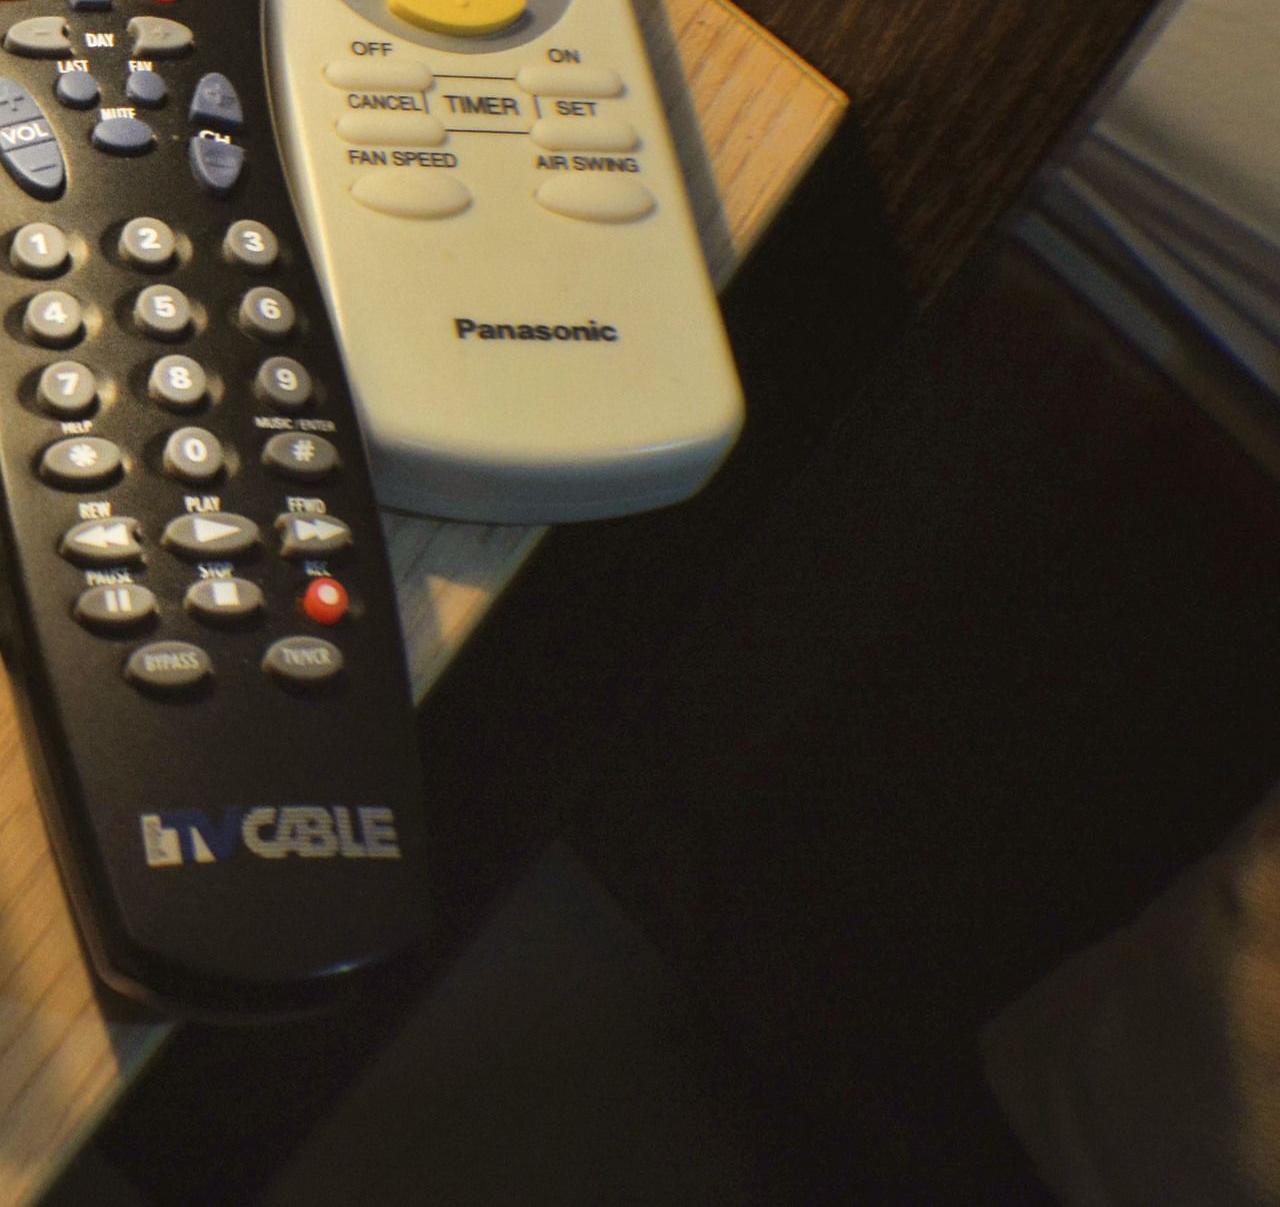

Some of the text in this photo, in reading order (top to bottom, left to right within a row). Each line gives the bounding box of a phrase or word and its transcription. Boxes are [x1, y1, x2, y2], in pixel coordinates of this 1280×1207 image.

[85, 33, 115, 49] DAY
[351, 40, 393, 57] OFF
[57, 59, 90, 73] LAST
[548, 48, 582, 65] ON
[348, 93, 422, 112] CANCEL
[443, 94, 520, 116] TIMER
[556, 100, 598, 117] SET
[100, 107, 137, 121] MUTE
[1, 122, 48, 144] VOL
[348, 150, 459, 169] FAN SPEED
[536, 154, 639, 174] AIR SWING
[29, 233, 48, 255] 1
[137, 228, 161, 250] 2
[243, 231, 265, 252] 3
[43, 301, 68, 324] 4
[152, 296, 176, 318] 5
[260, 299, 280, 320] 6
[453, 316, 620, 343] Panasonic
[56, 372, 81, 396] 7
[168, 366, 192, 390] 8
[276, 368, 298, 391] 9
[61, 421, 93, 435] HELP
[184, 438, 208, 462] 0
[185, 496, 221, 514] PLAY
